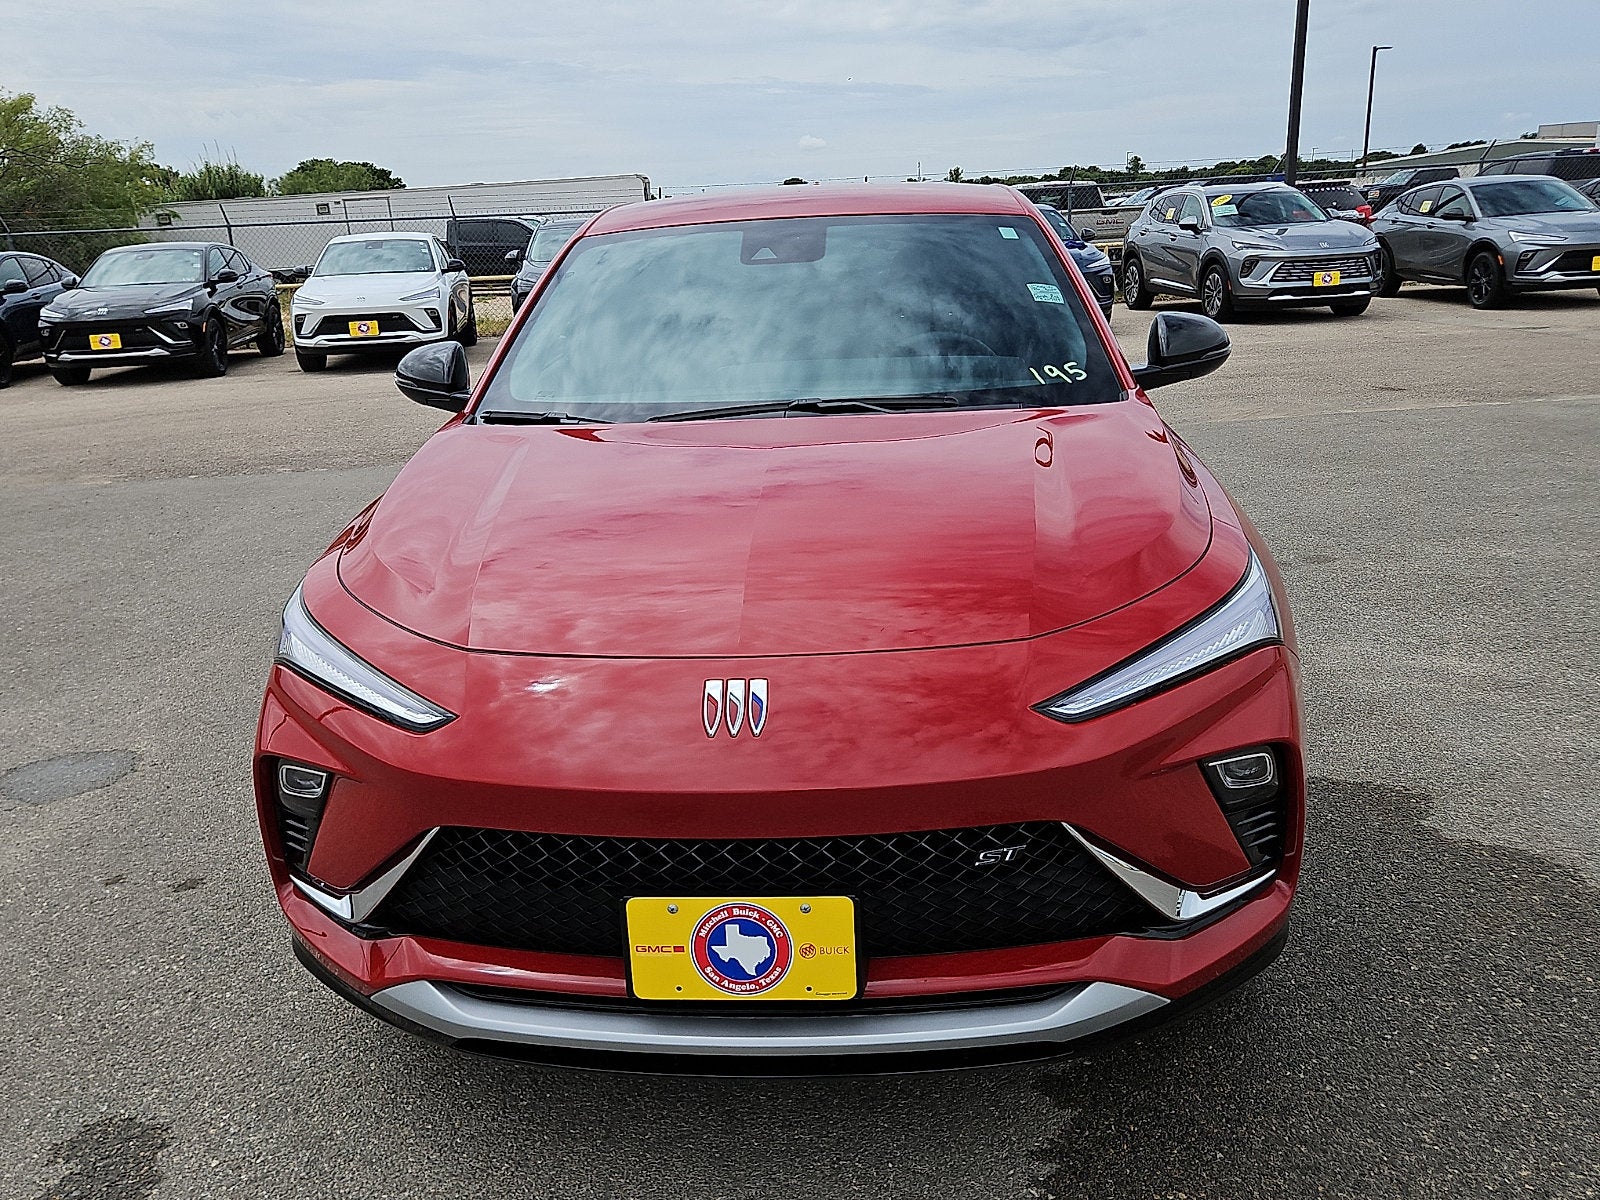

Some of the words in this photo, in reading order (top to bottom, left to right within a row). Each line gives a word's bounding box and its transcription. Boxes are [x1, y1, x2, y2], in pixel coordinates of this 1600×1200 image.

[1029, 361, 1088, 385] 195
[974, 844, 1027, 867] ST
[698, 910, 729, 938] Mitchell
[732, 907, 760, 919] Buick
[766, 919, 784, 938] GMC
[635, 945, 673, 953] GMC
[819, 946, 850, 955] BUICK
[704, 966, 720, 983] San
[720, 979, 760, 992] Angelo,
[759, 966, 782, 987] Texas
